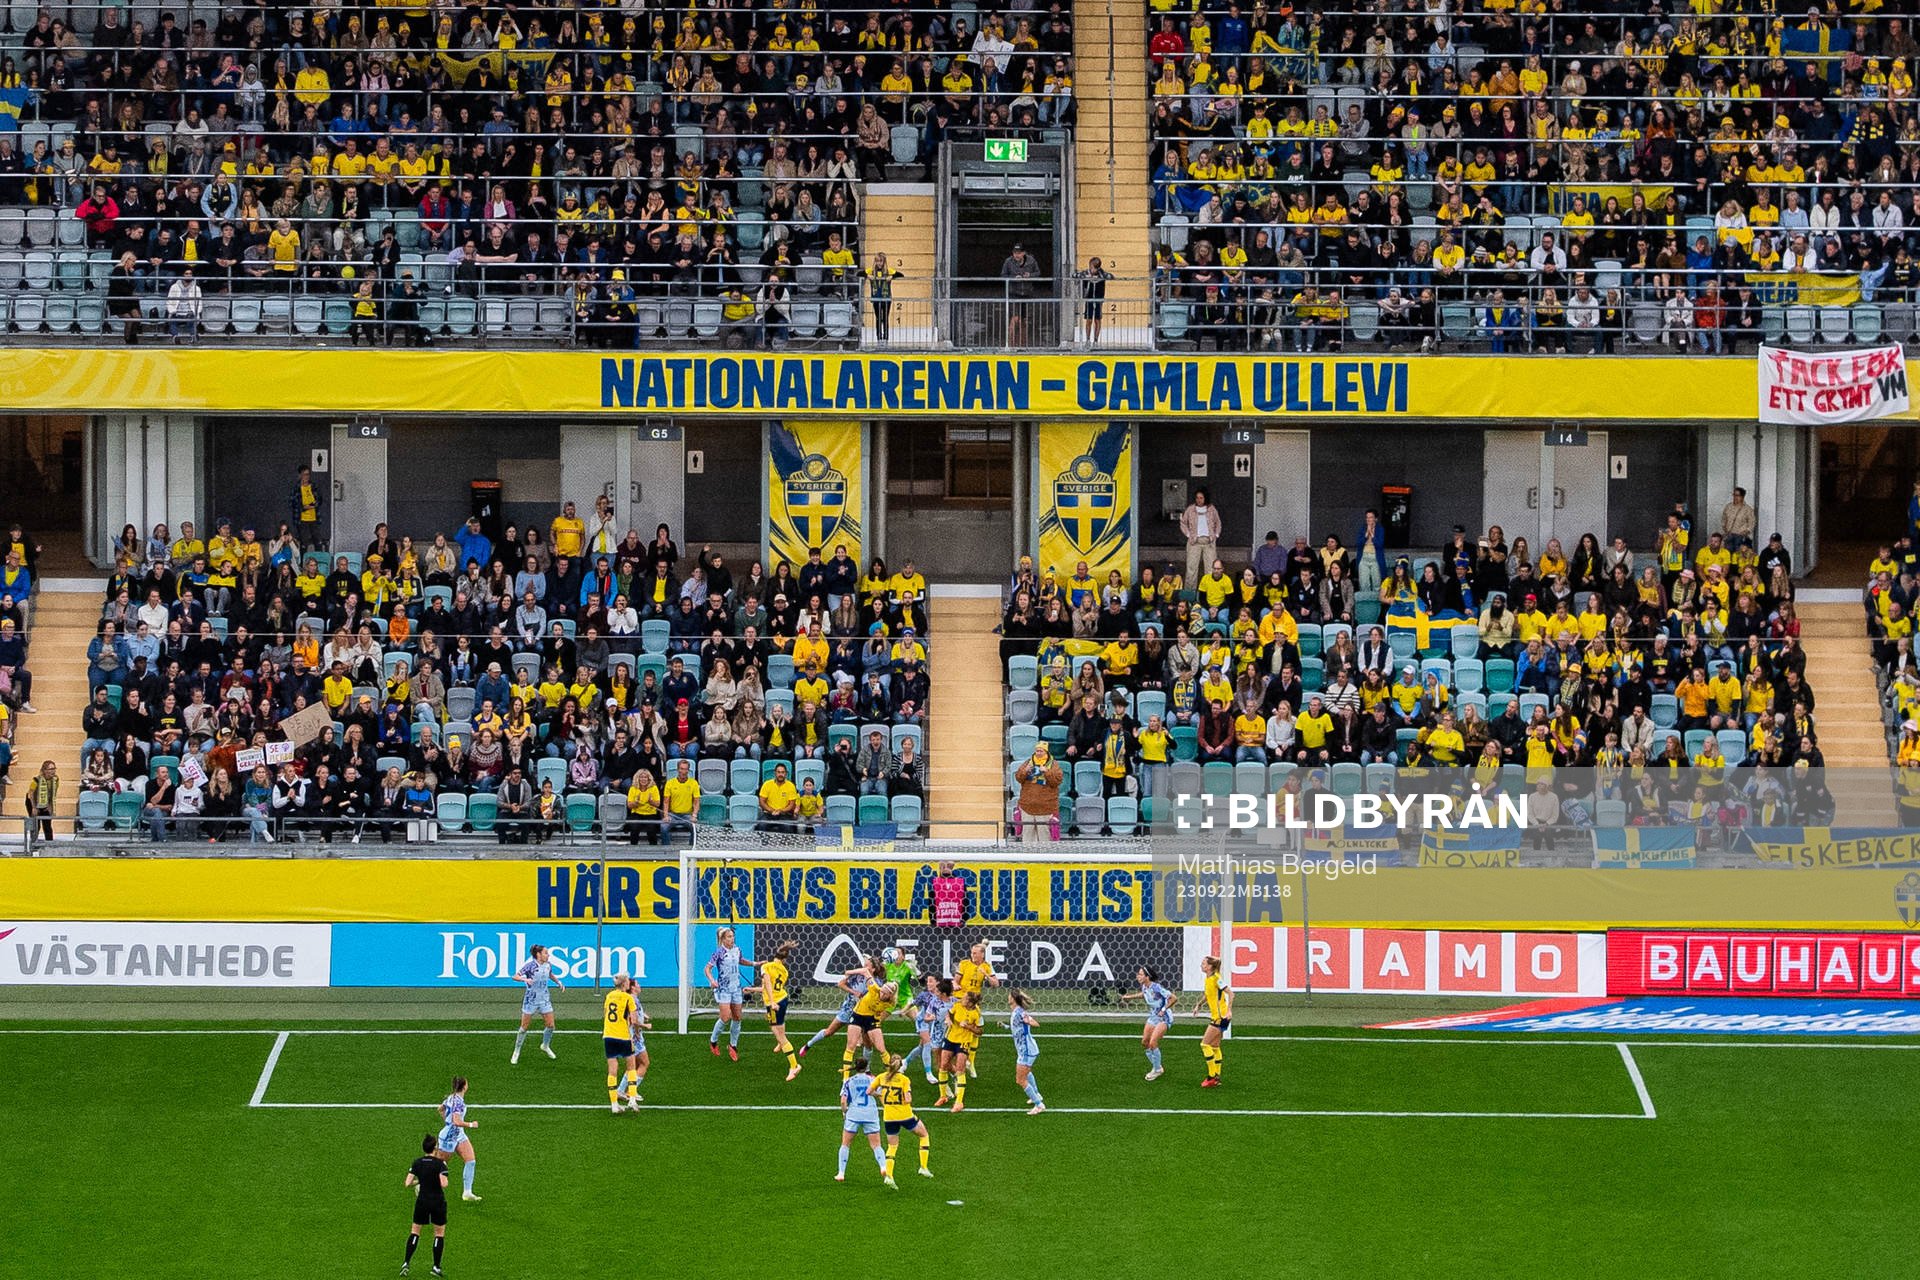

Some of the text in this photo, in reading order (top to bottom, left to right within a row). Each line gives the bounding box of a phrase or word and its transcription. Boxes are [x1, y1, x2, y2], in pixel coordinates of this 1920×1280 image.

[897, 259, 903, 267] 3
[1768, 350, 1846, 387] TACK
[601, 358, 1029, 410] NATIONALARENAN
[1077, 360, 1242, 411] GAMLA
[1252, 362, 1408, 412] ULLEVI
[1769, 370, 1908, 412] ETT GRYMT VM
[361, 426, 378, 436] G4
[651, 428, 668, 439] G5
[793, 482, 837, 490] SVERIGE
[1062, 484, 1107, 492] SVERIGE
[537, 863, 1283, 923] HÄR SKRIVS BLÅGUL HISTORIA
[16, 935, 294, 978] VÄSTANHEDE
[1230, 939, 1562, 980] CRAMO
[774, 974, 784, 991] 6
[607, 1002, 618, 1022] 8
[856, 1086, 869, 1107] 3
[881, 1085, 903, 1105] 23
